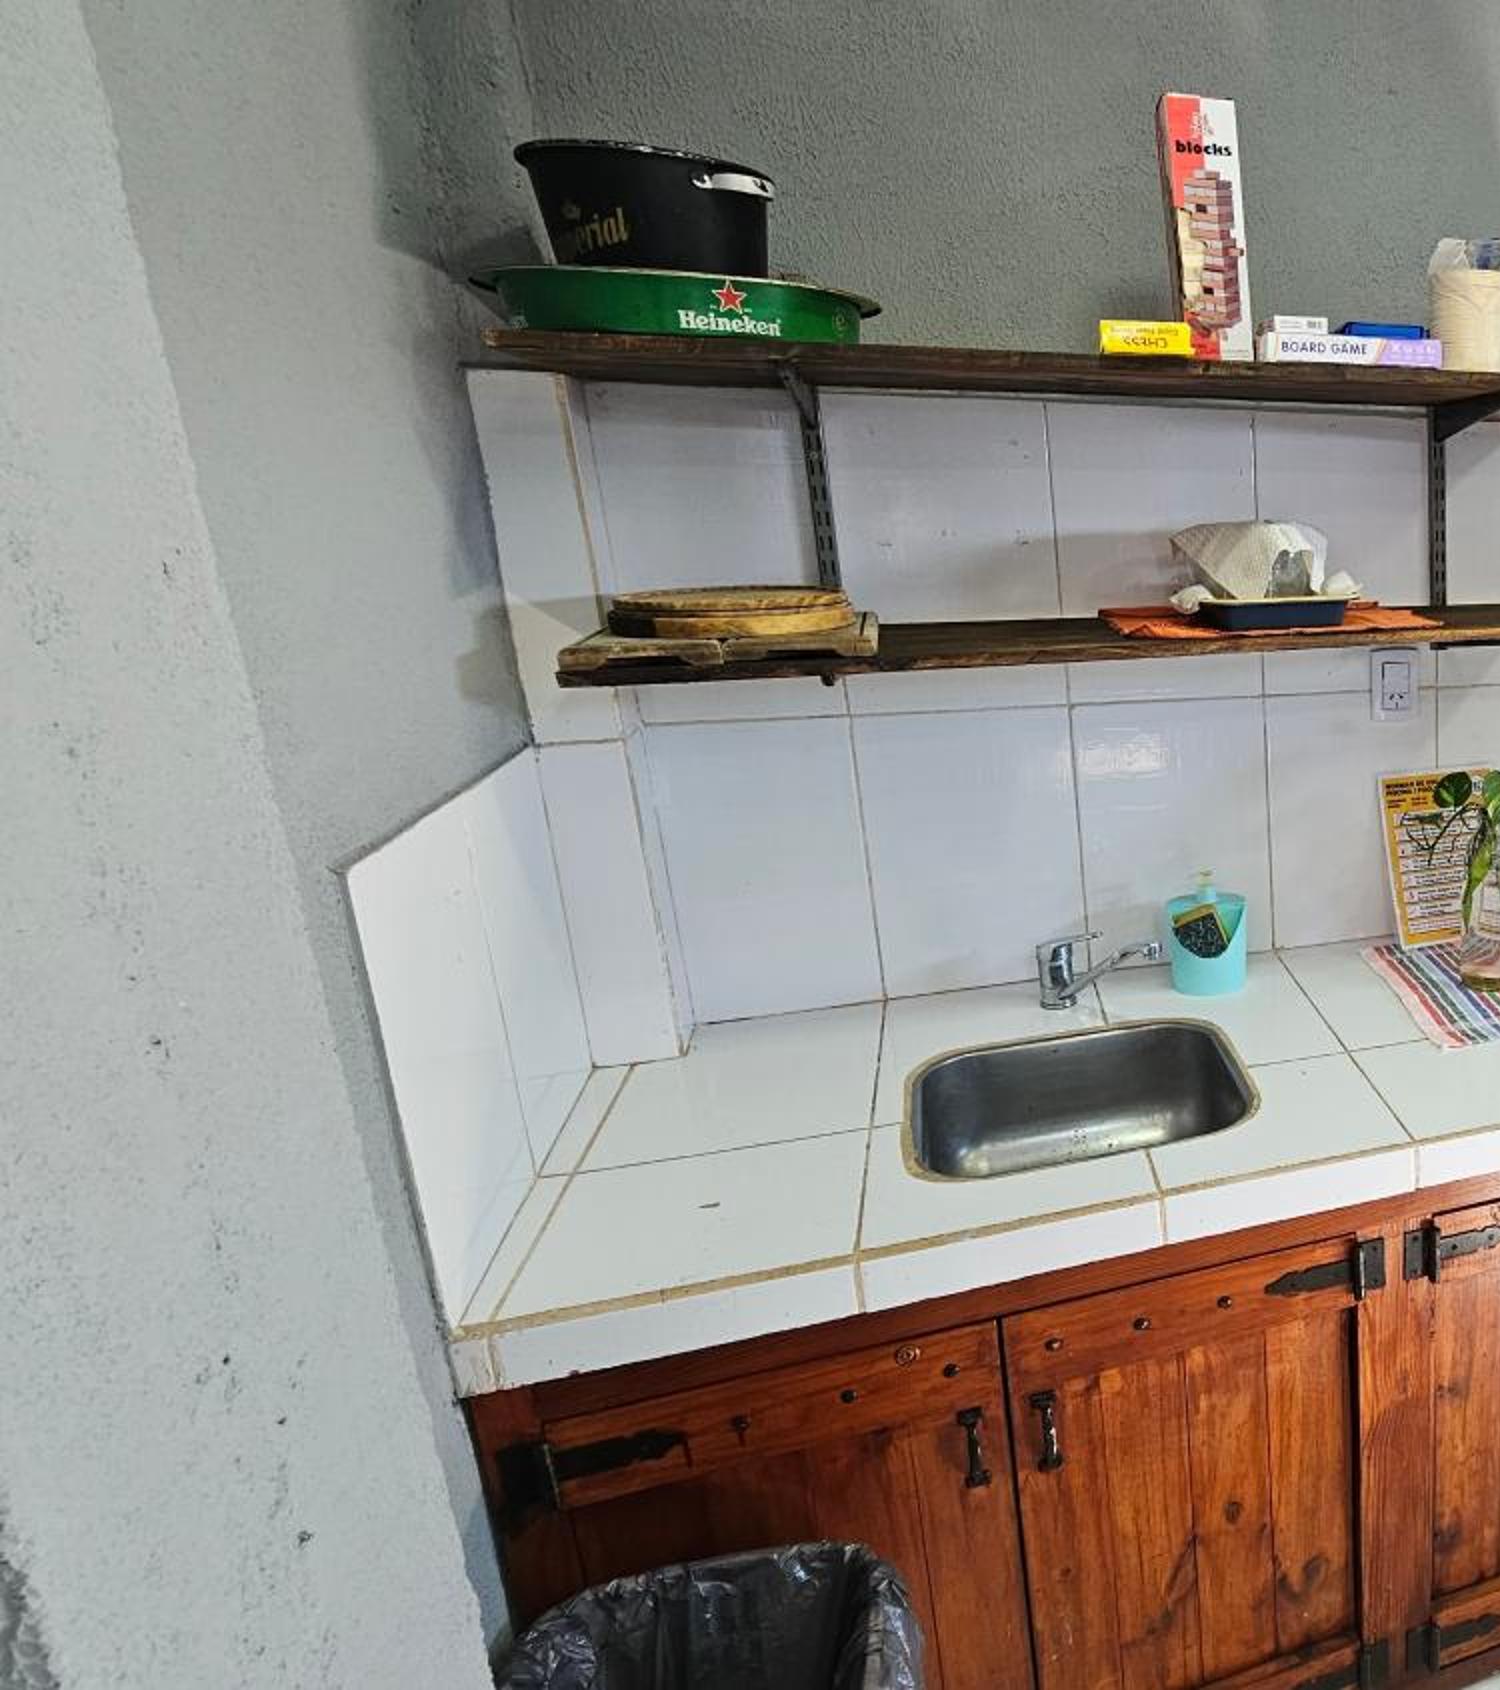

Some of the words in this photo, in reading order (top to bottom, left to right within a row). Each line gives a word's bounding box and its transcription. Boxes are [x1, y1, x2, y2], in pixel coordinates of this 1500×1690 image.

[1174, 139, 1233, 157] blocks
[677, 308, 781, 337] Heineken
[1280, 341, 1327, 354] BOARD
[1331, 343, 1368, 356] GAME
